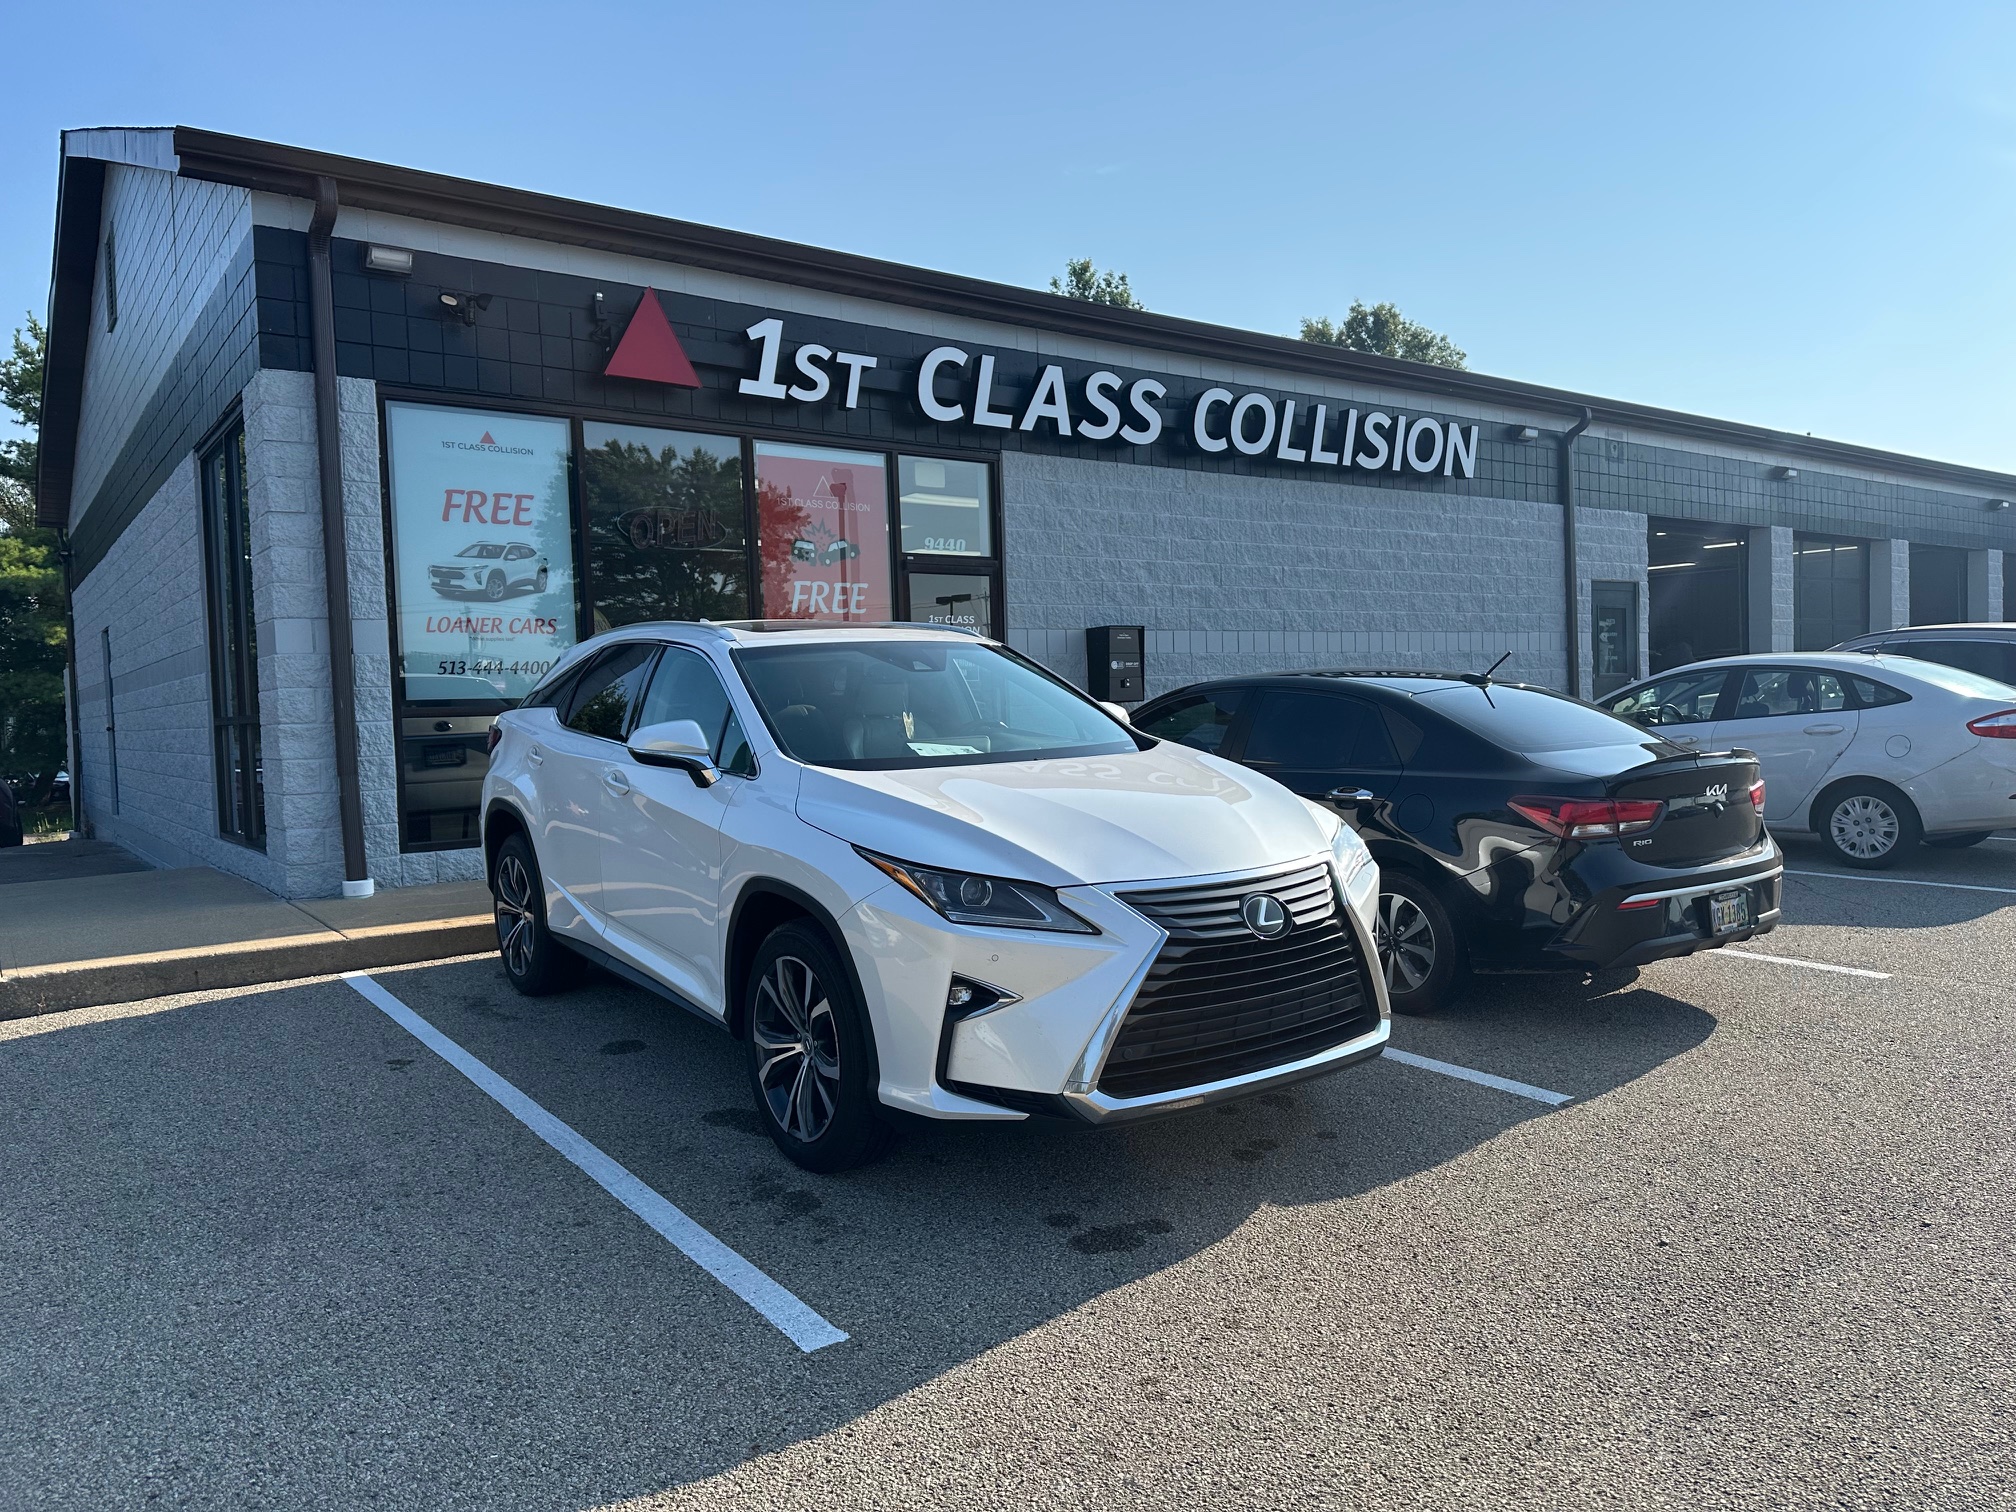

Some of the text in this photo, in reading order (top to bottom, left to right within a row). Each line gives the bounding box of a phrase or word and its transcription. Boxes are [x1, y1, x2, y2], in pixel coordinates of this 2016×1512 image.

[738, 317, 1479, 479] 1ST CLASS COLLISION
[441, 440, 534, 456] 1ST CLASS COLLISION
[441, 489, 535, 526] FREE
[794, 498, 824, 509] CLASS
[825, 500, 871, 512] COLLISION
[630, 508, 716, 549] OPEN
[924, 536, 966, 552] 9440
[791, 580, 869, 614] FREE
[425, 616, 558, 635] LOANER CARS
[928, 614, 975, 624] 1ST CLASS
[437, 660, 551, 675] 513-444-4400
[1633, 838, 1653, 846] RIO
[1727, 902, 1746, 925] 1385
